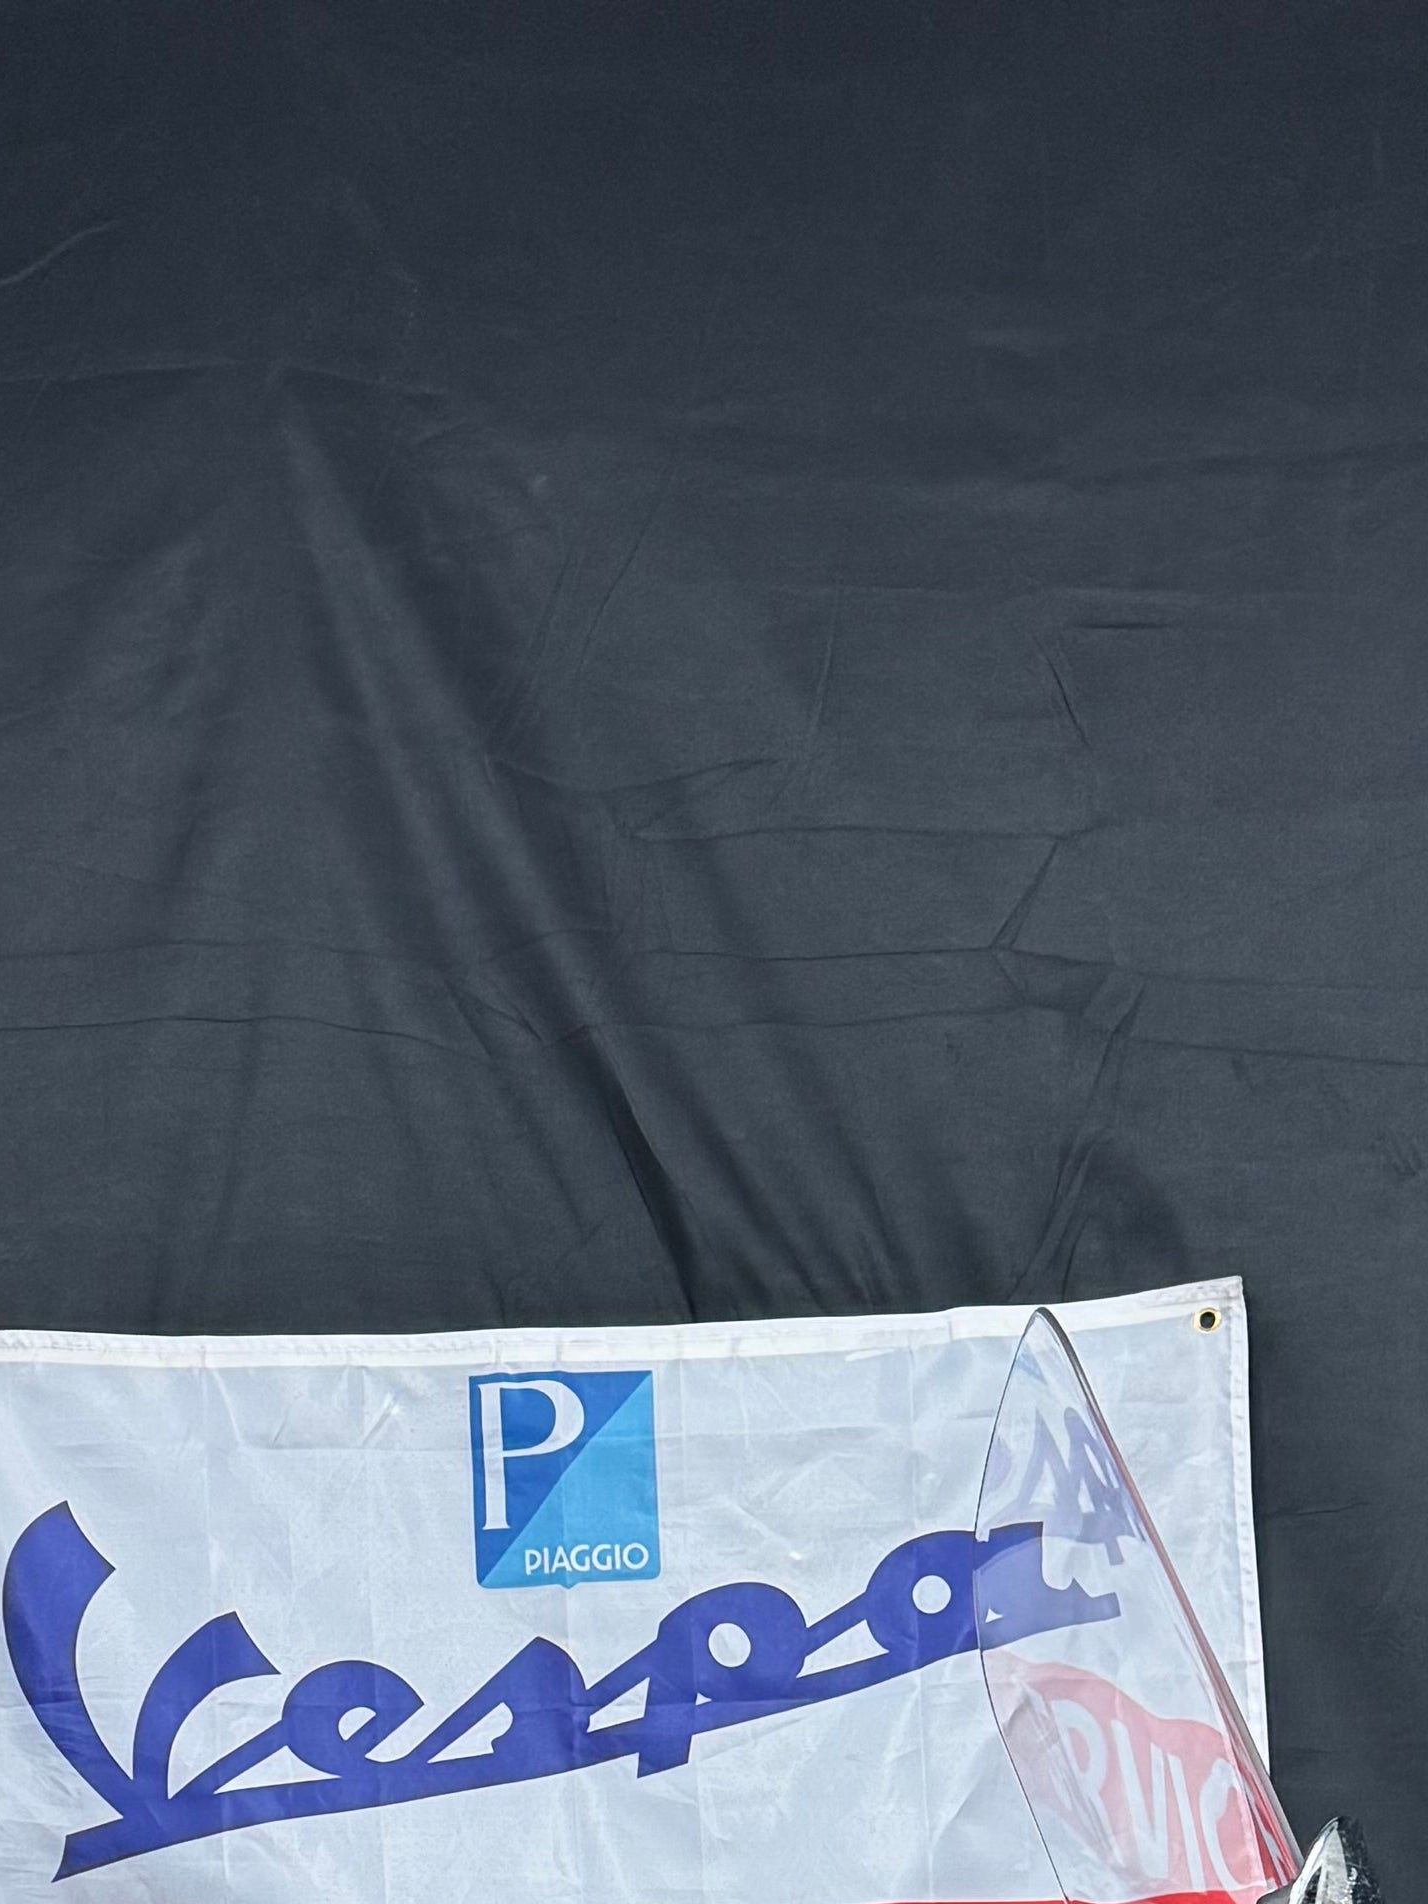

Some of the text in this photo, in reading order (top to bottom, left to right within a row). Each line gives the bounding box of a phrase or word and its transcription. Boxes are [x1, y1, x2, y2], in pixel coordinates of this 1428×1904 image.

[477, 1379, 585, 1531] P
[524, 1541, 650, 1576] PIAGGIO
[3, 1499, 1121, 1882] Vespa
